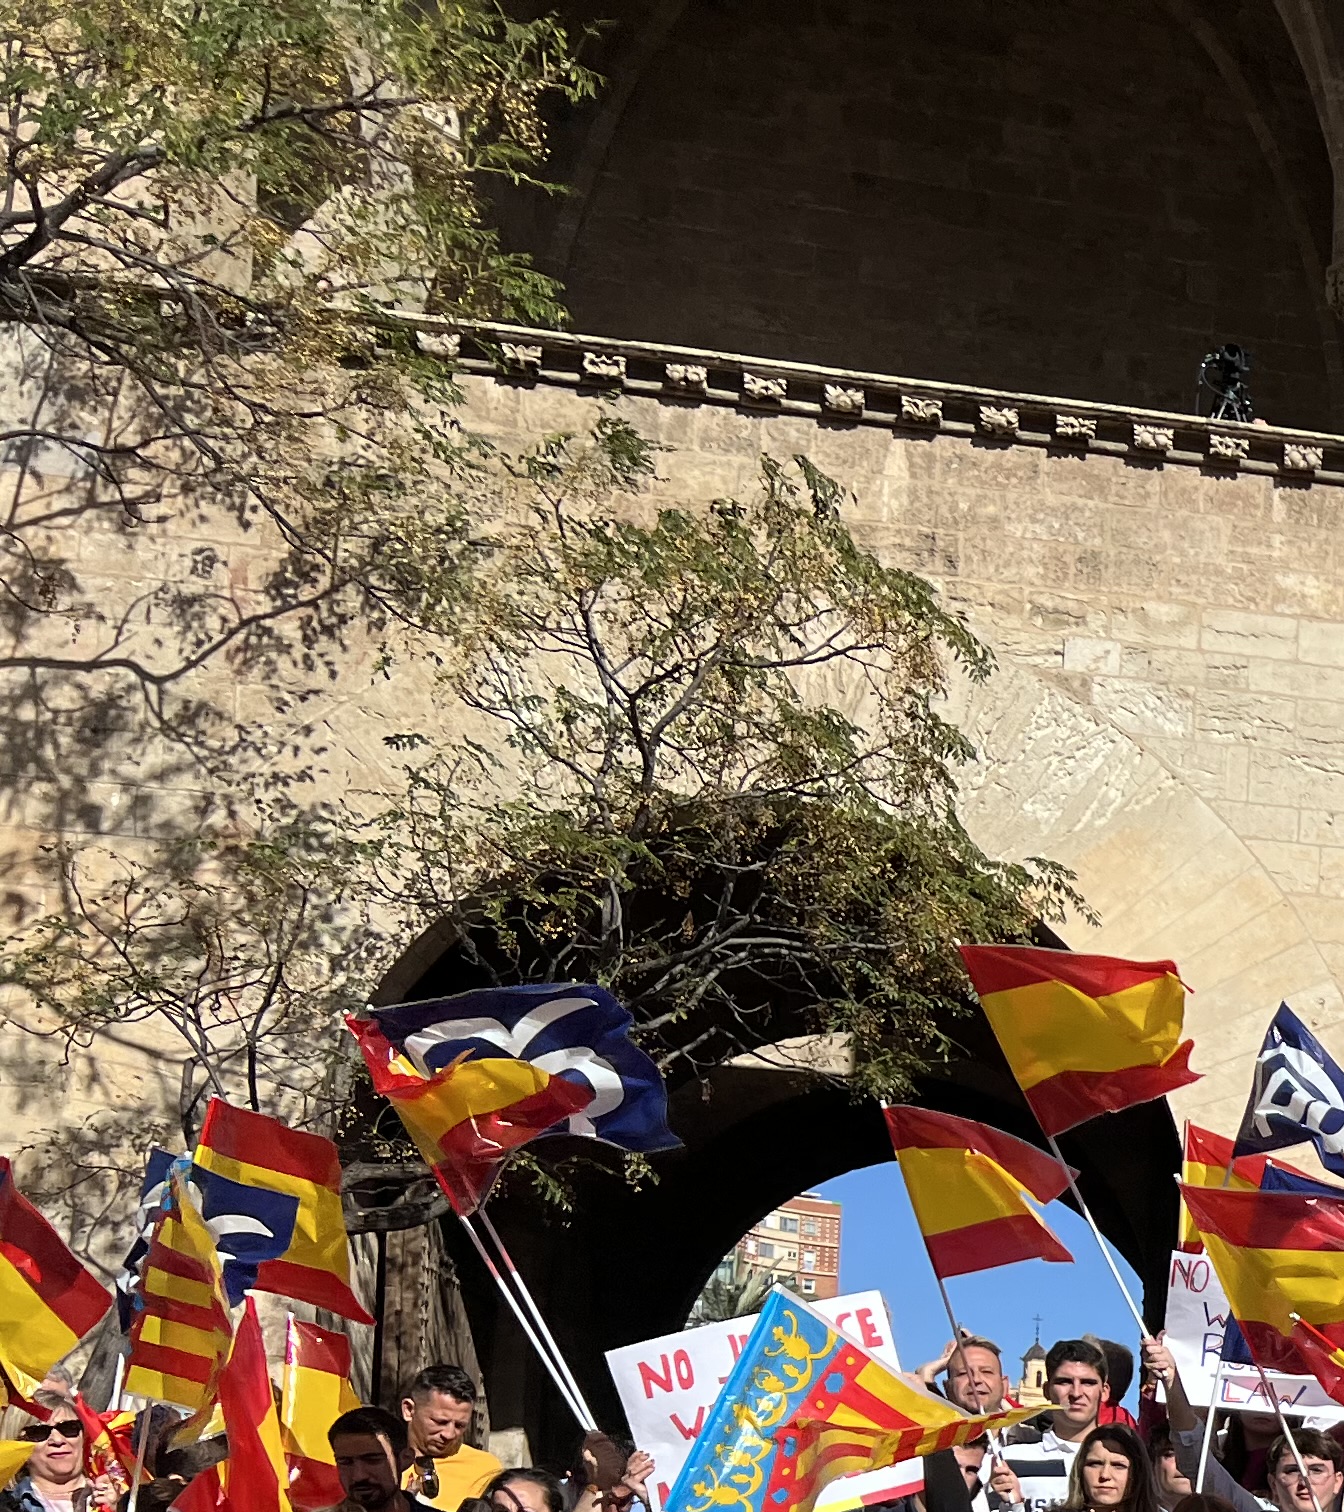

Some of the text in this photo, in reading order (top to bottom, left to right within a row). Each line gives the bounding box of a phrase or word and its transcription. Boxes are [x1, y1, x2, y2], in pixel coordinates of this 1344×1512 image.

[1170, 1258, 1210, 1293] NO
[637, 1348, 694, 1399] NO
[1221, 1378, 1308, 1409] LAW
